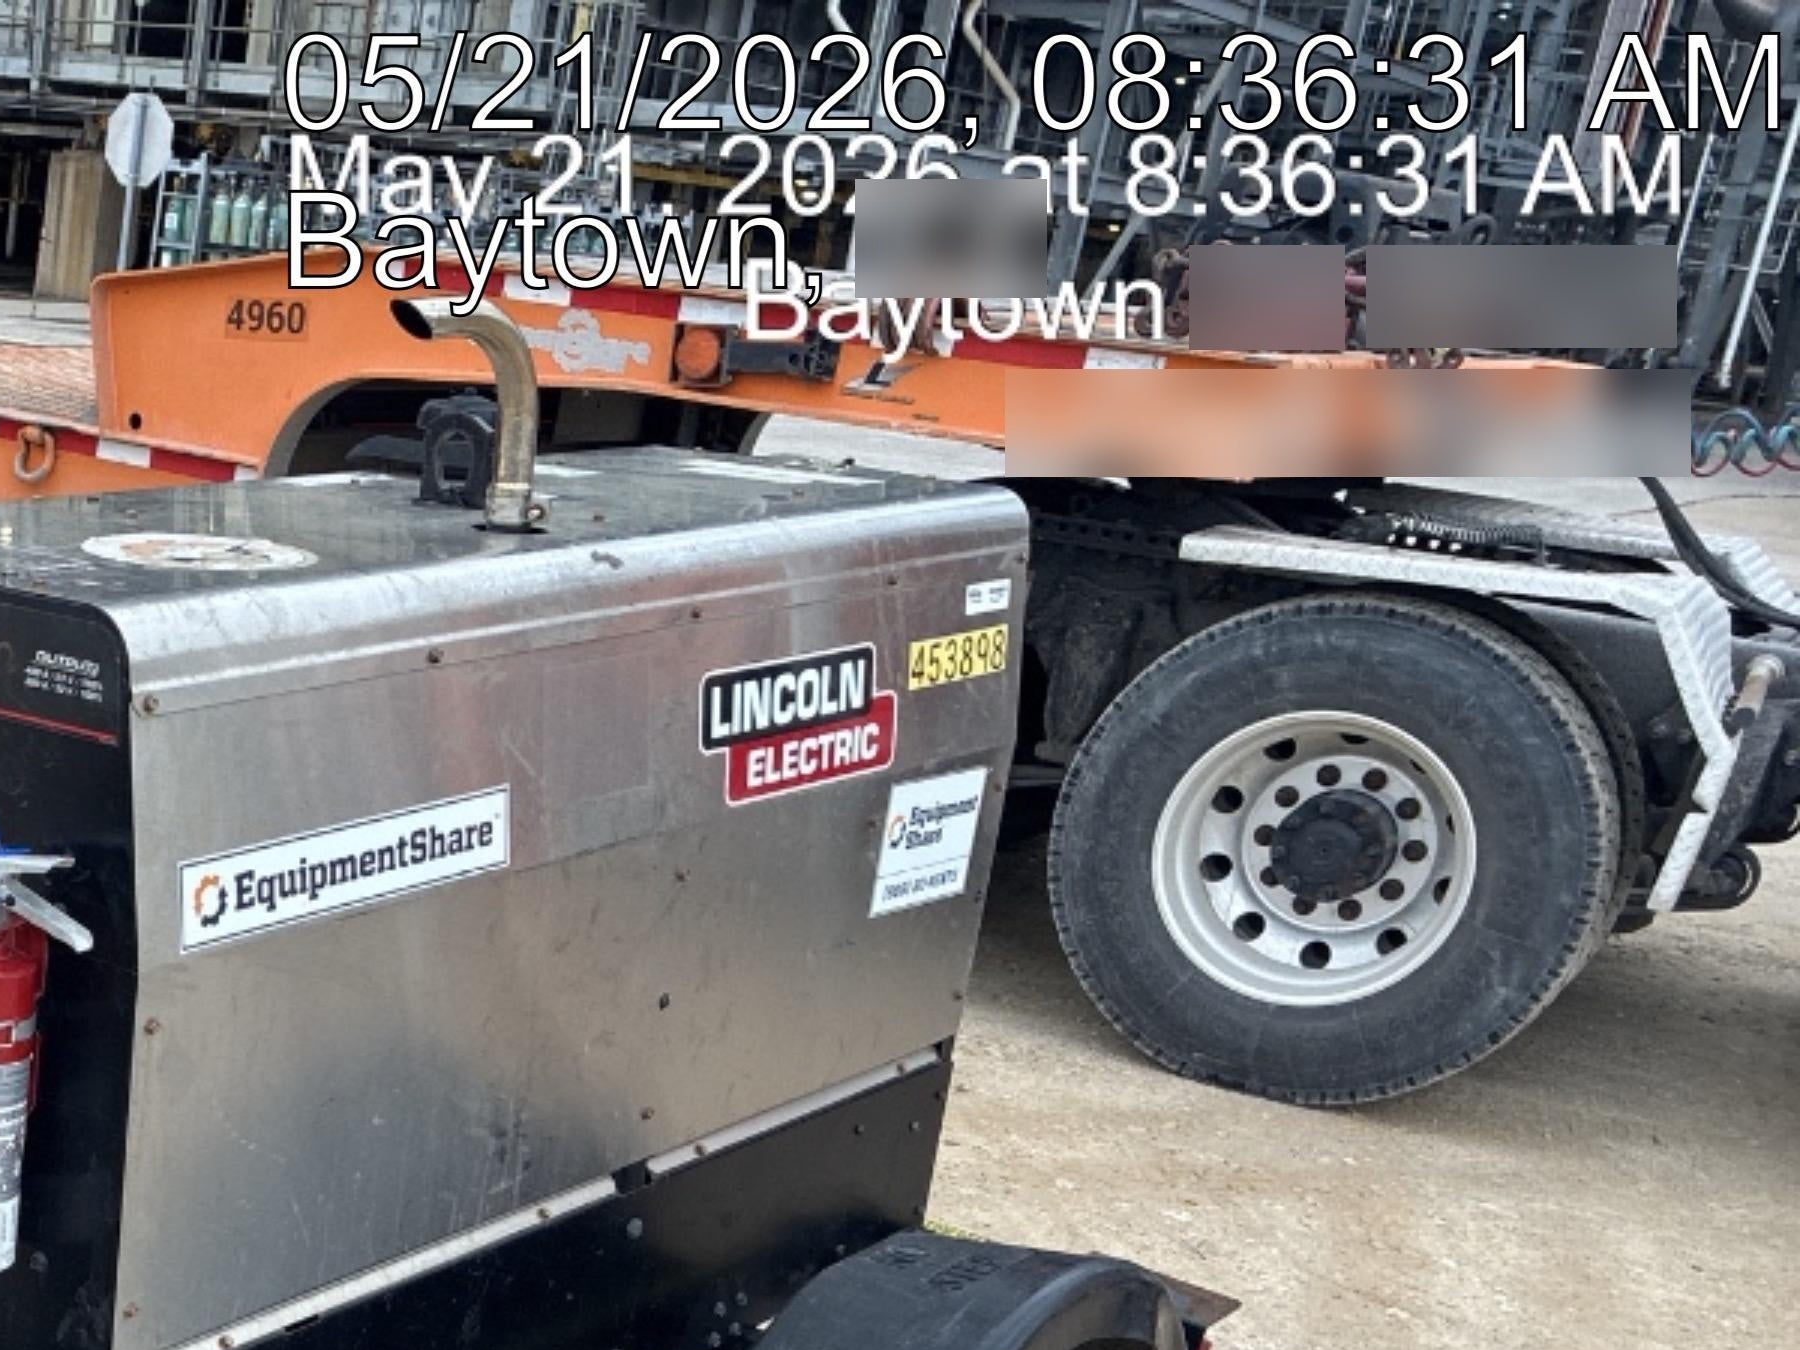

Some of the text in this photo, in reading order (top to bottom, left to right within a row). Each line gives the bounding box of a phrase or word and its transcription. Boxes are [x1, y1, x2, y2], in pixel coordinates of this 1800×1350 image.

[226, 298, 306, 334] 4960
[911, 629, 1005, 685] 453898
[709, 658, 867, 740] LINCOLN
[746, 721, 881, 789] ELECTRIC
[233, 820, 494, 912] EquipmentShare
